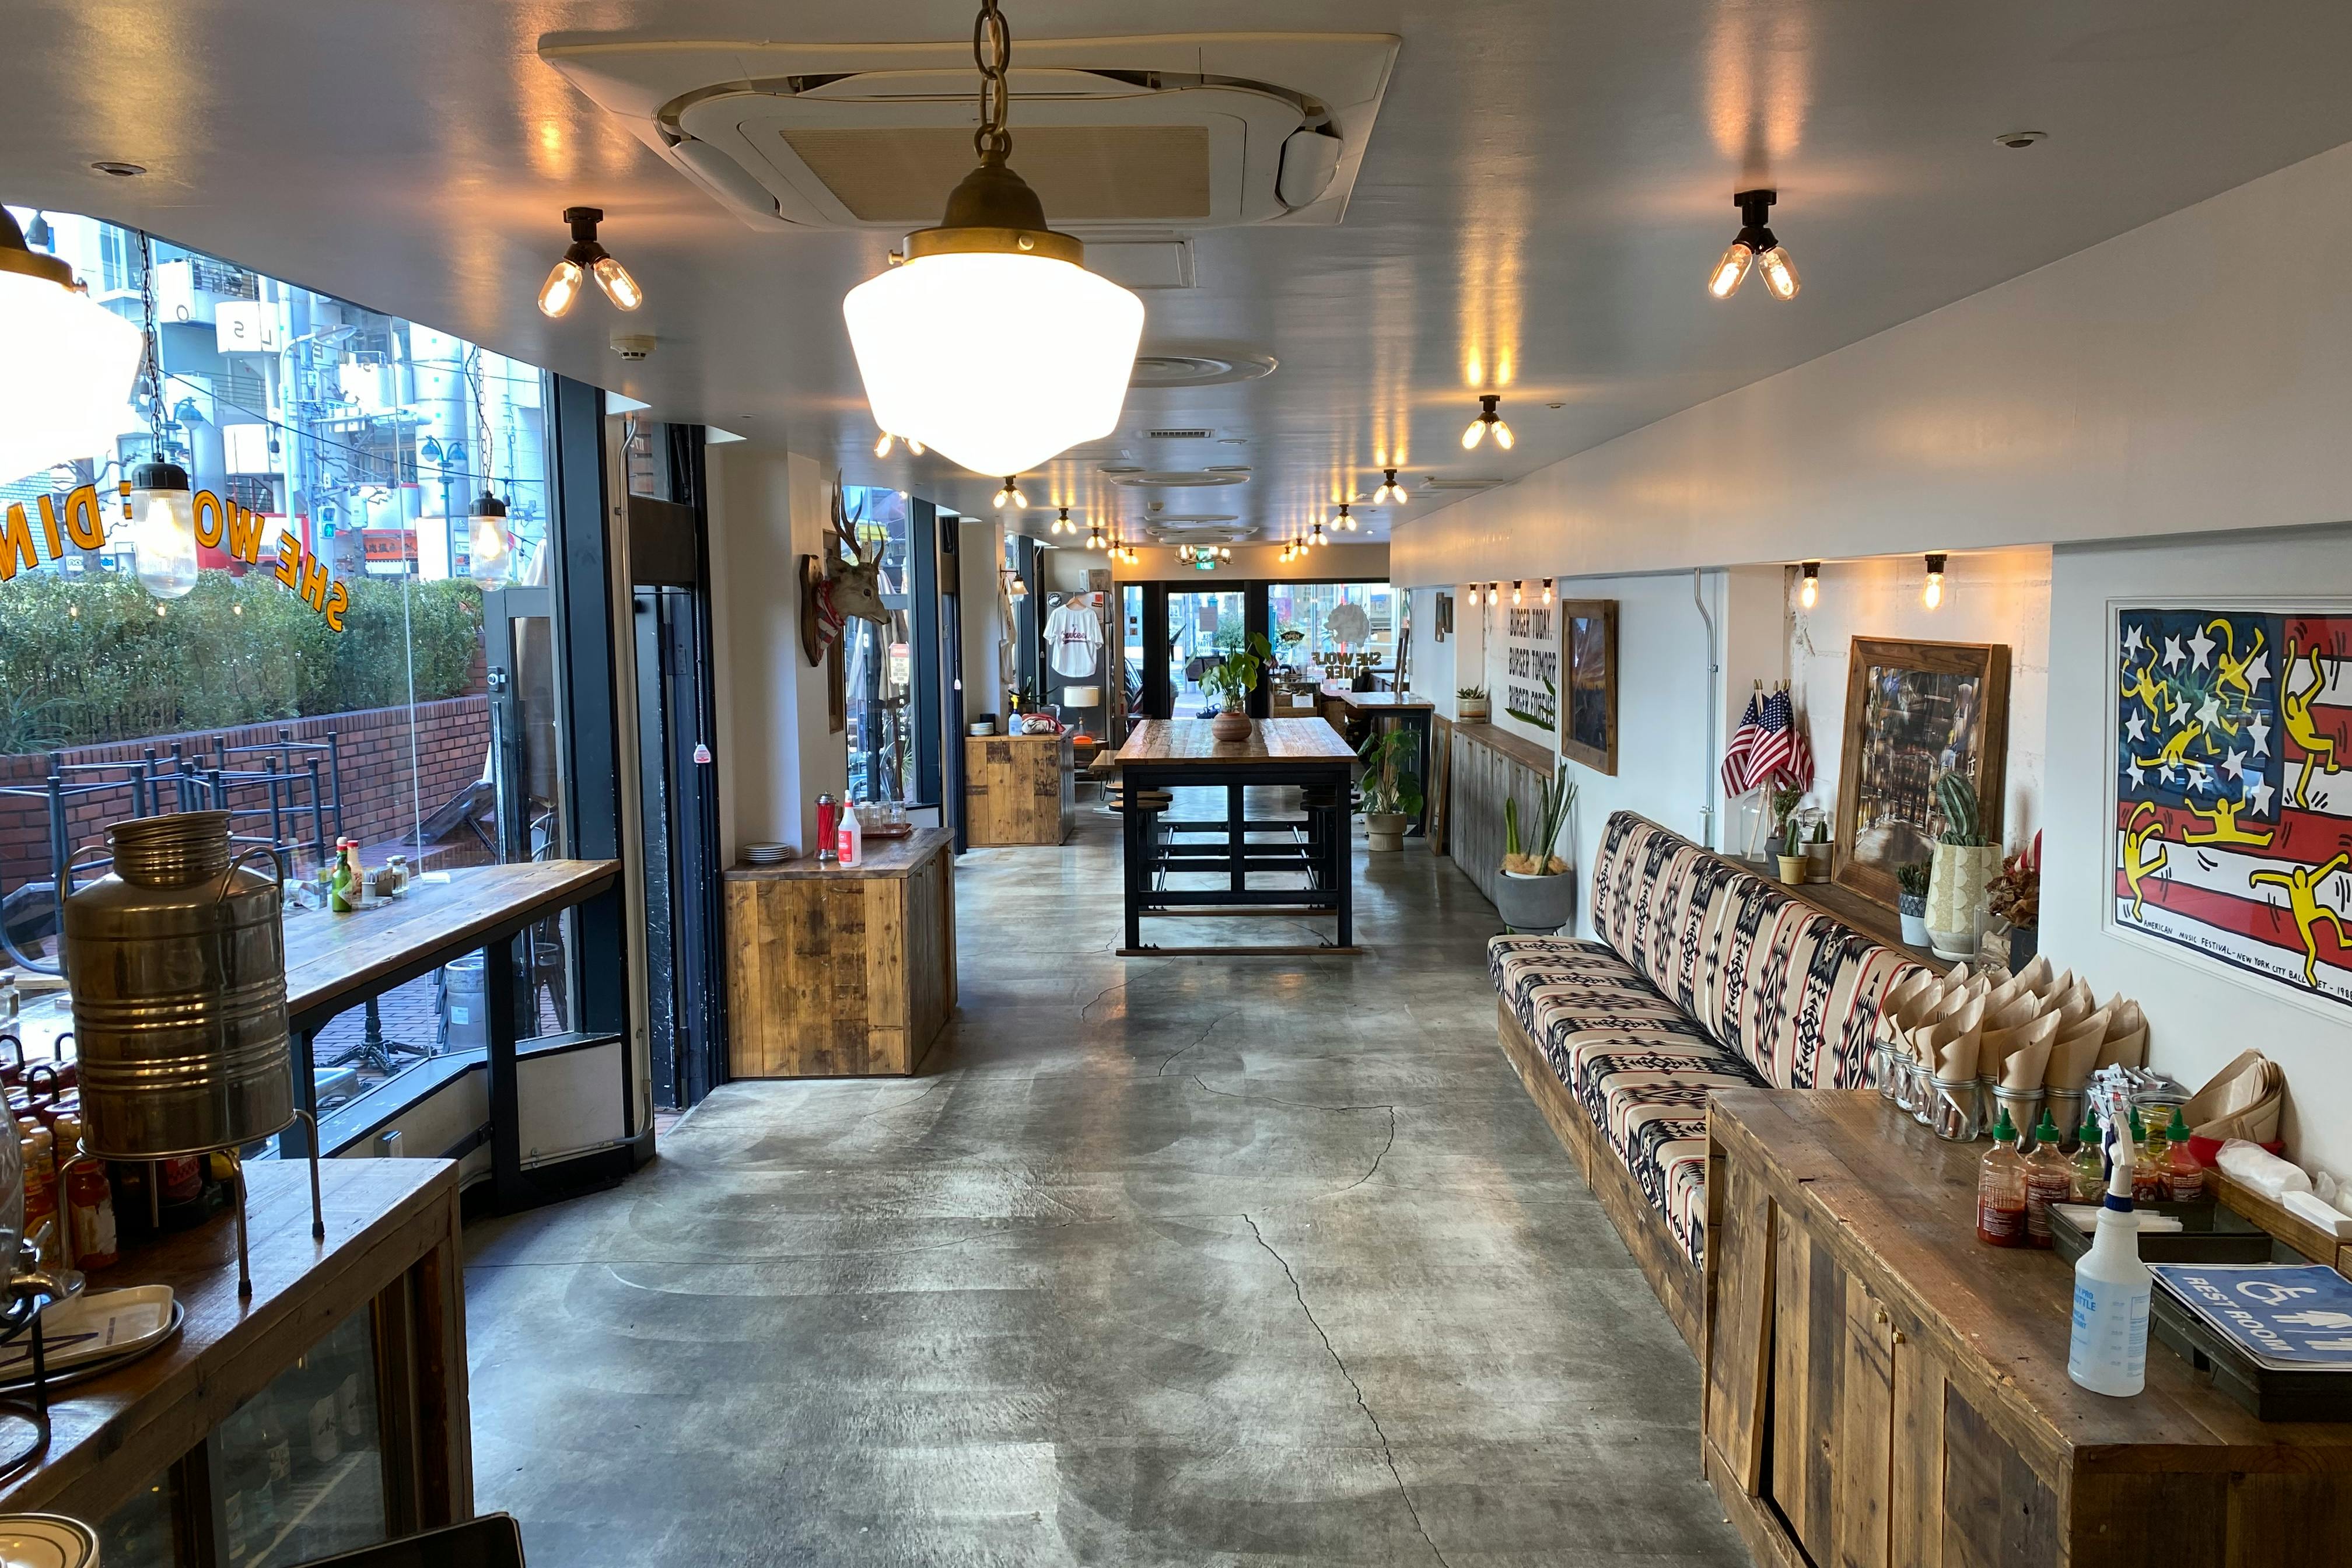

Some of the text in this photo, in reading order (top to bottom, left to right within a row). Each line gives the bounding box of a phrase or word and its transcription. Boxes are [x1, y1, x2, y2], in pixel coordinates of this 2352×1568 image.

[1510, 608, 1530, 638] BURGER
[1508, 647, 1529, 678] BURGER
[1508, 685, 1528, 713] BURGER
[2144, 920, 2173, 934] AMERICAN
[2179, 932, 2197, 943] MUSIC
[2255, 957, 2270, 970] YORK
[2272, 965, 2286, 975] CITY
[2183, 1277, 2296, 1351] REST ROOM
